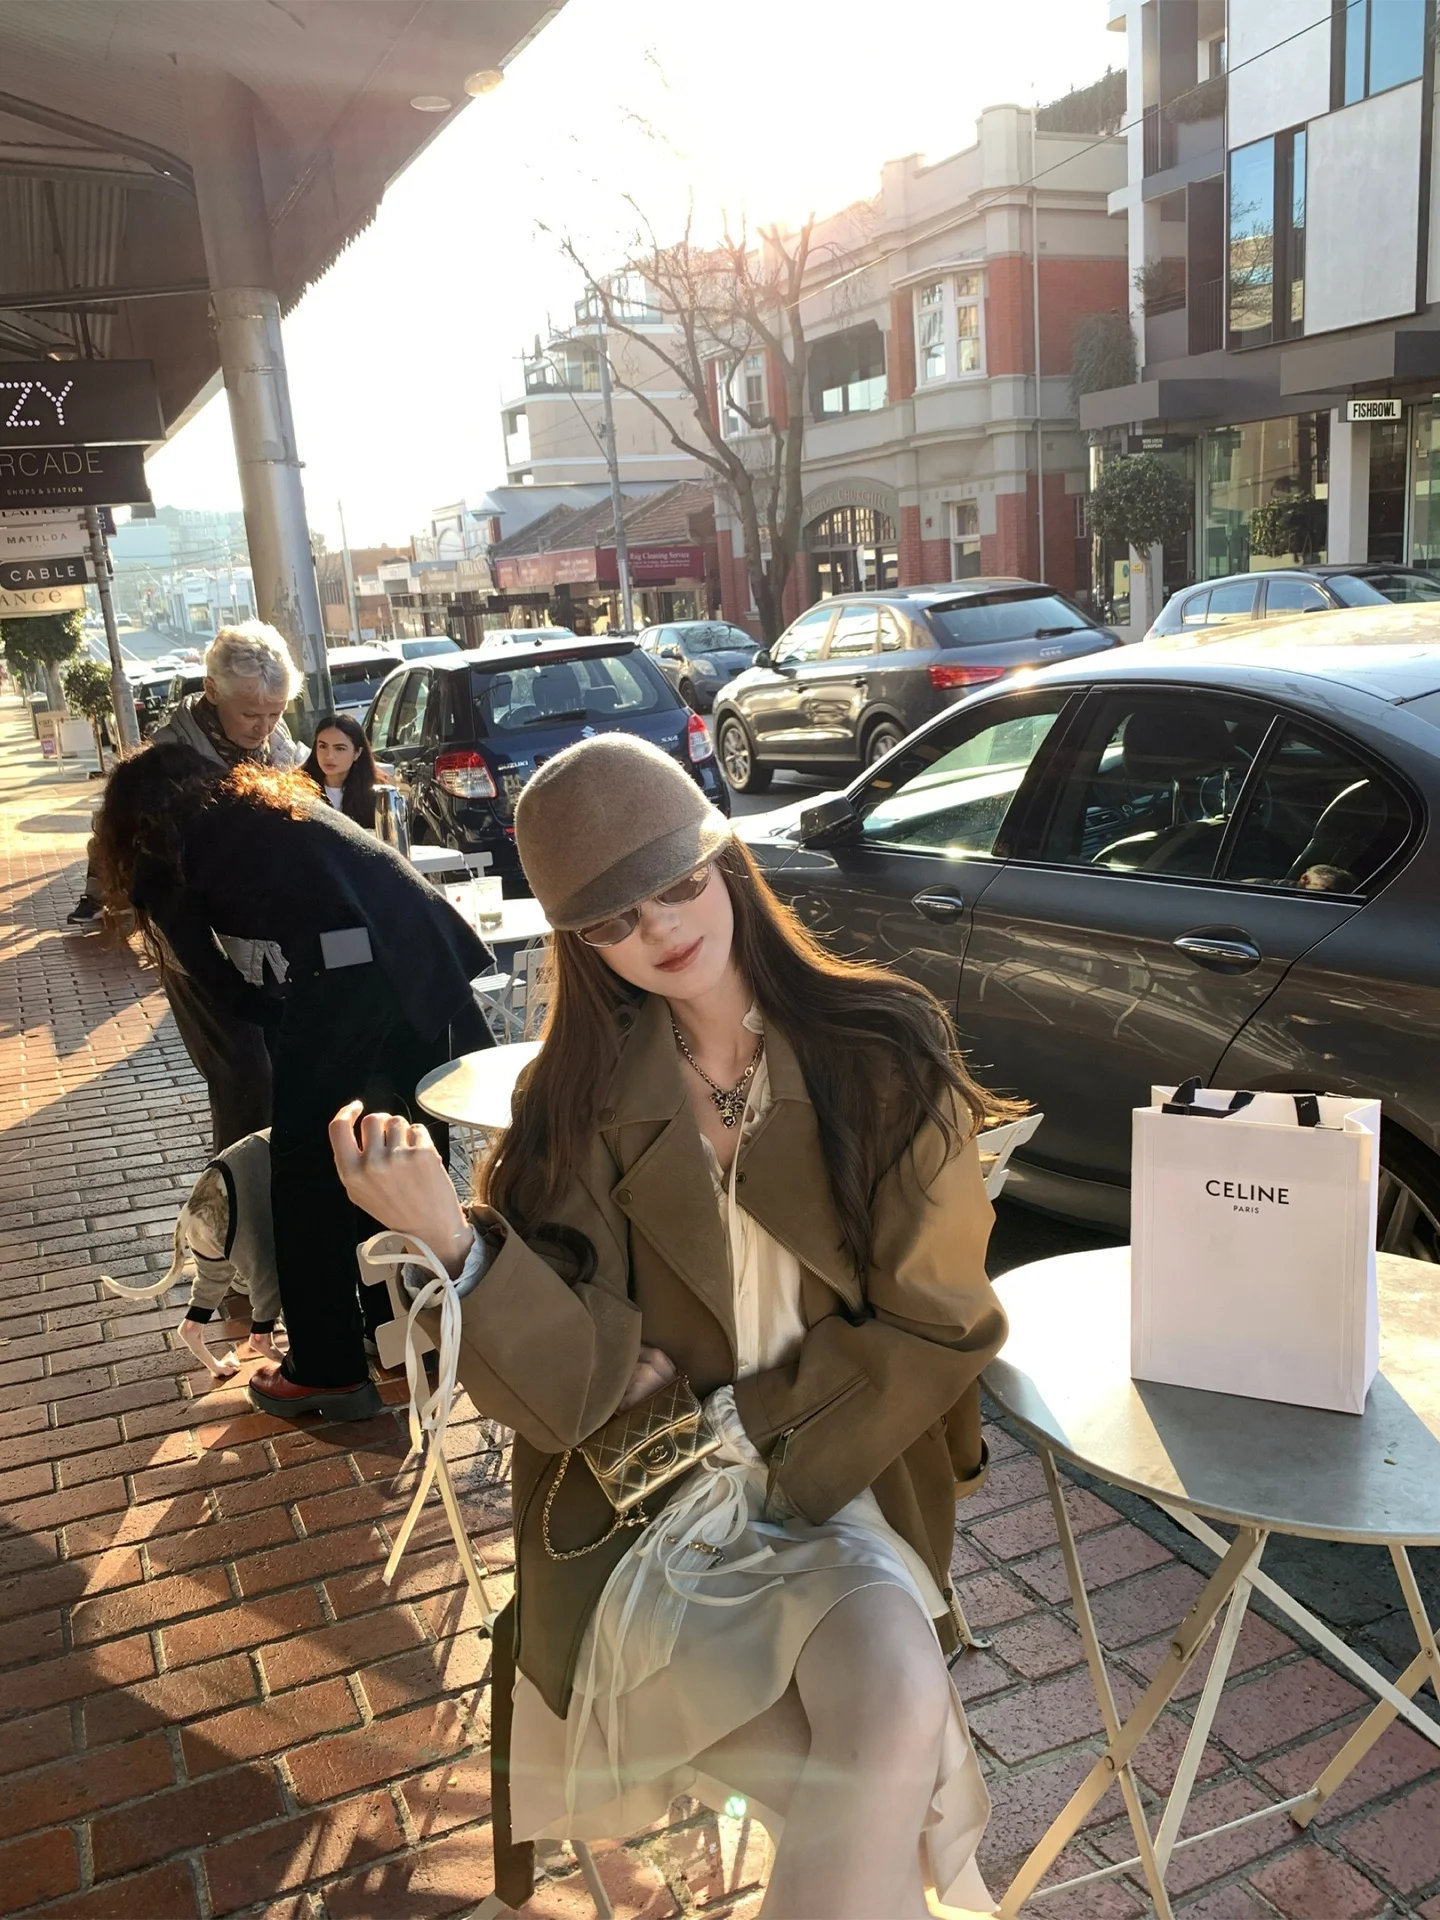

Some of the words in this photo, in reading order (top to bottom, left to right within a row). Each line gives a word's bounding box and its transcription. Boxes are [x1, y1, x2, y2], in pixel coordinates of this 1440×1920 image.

[0, 380, 74, 427] ZY
[1353, 402, 1396, 418] FISHBOWL
[6, 488, 35, 496] SHOPS
[38, 487, 44, 495] &
[46, 486, 84, 494] STATION
[837, 487, 889, 510] CHURCHILL
[7, 532, 68, 544] MATILDA
[642, 552, 668, 560] Cleaning
[668, 551, 690, 559] Service
[10, 565, 77, 582] CABLE
[1205, 1180, 1290, 1205] CELINE
[1233, 1205, 1260, 1214] PARIS
